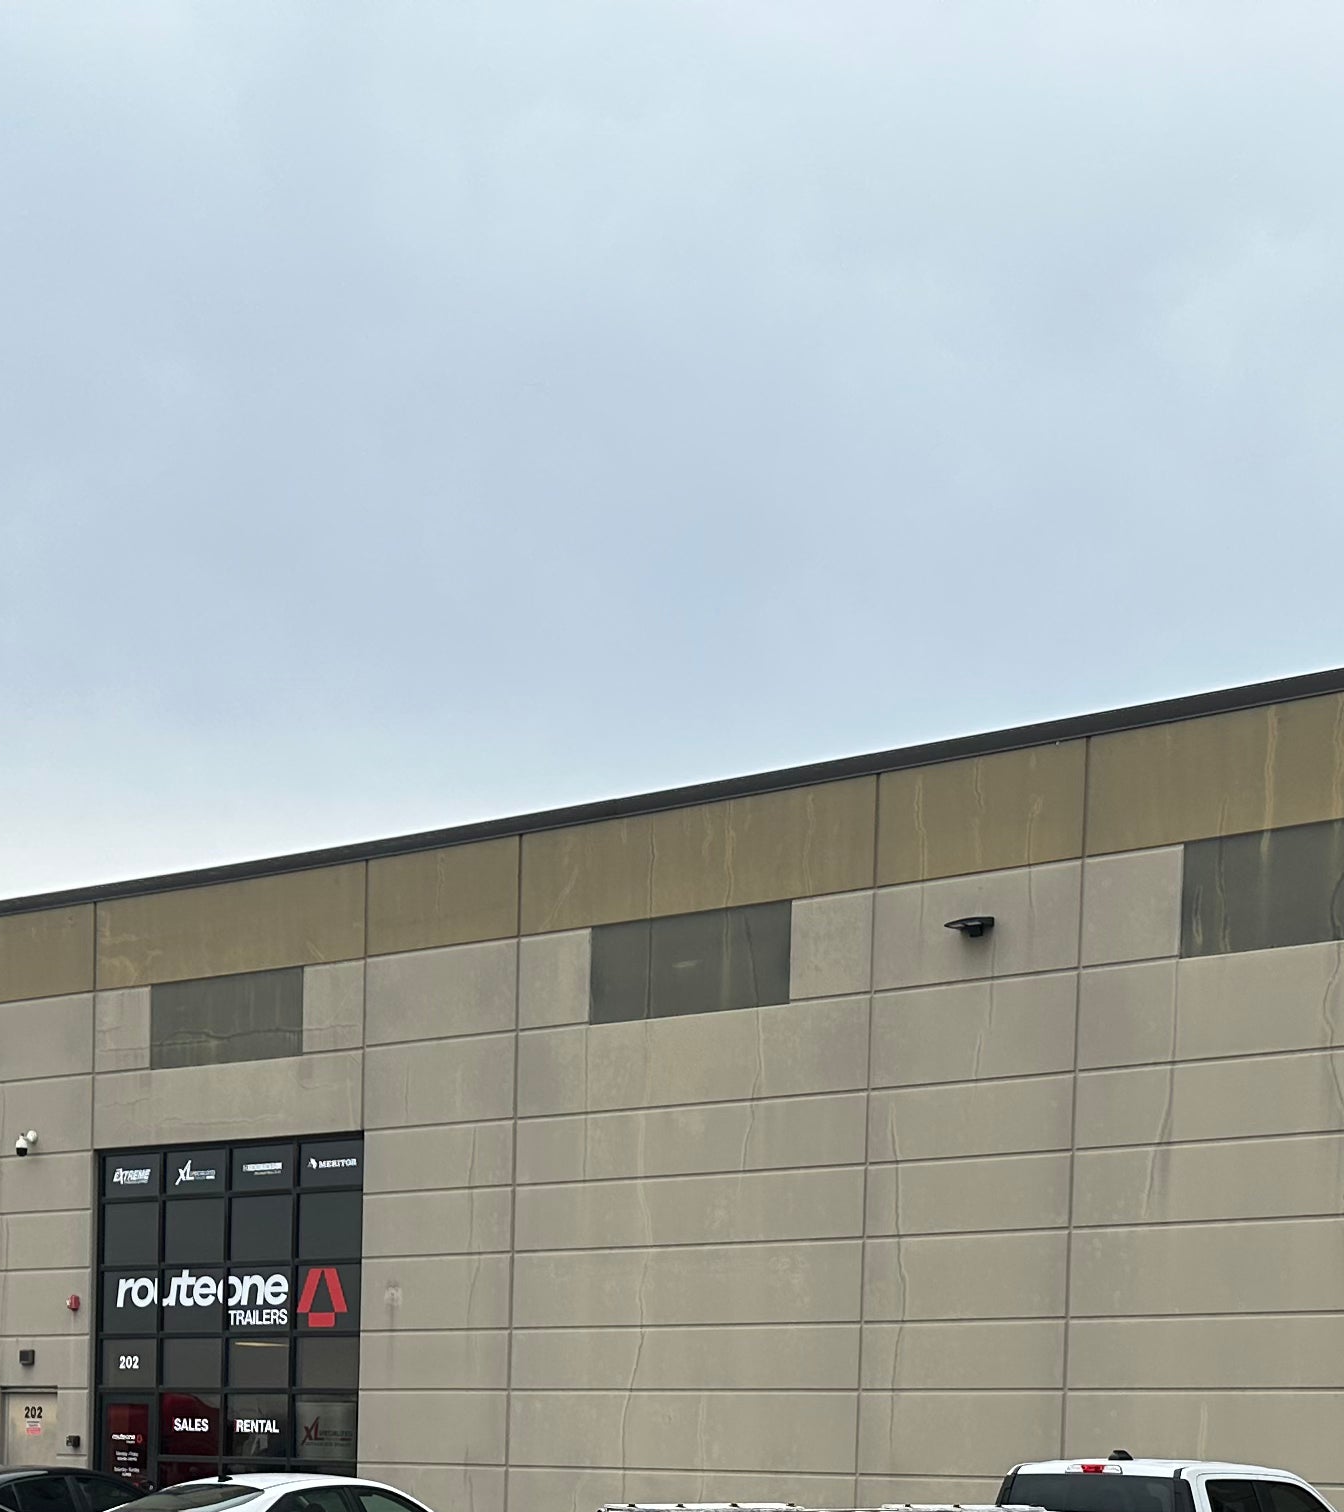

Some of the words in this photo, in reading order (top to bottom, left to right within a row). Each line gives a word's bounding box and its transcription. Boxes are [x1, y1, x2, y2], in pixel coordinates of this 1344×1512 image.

[175, 1160, 194, 1185] XL
[116, 1269, 289, 1307] routeone
[228, 1309, 288, 1325] TRAILERS
[119, 1356, 139, 1369] 202
[24, 1406, 43, 1418] 202
[173, 1418, 209, 1432] SALES
[235, 1419, 279, 1433] RENTAL
